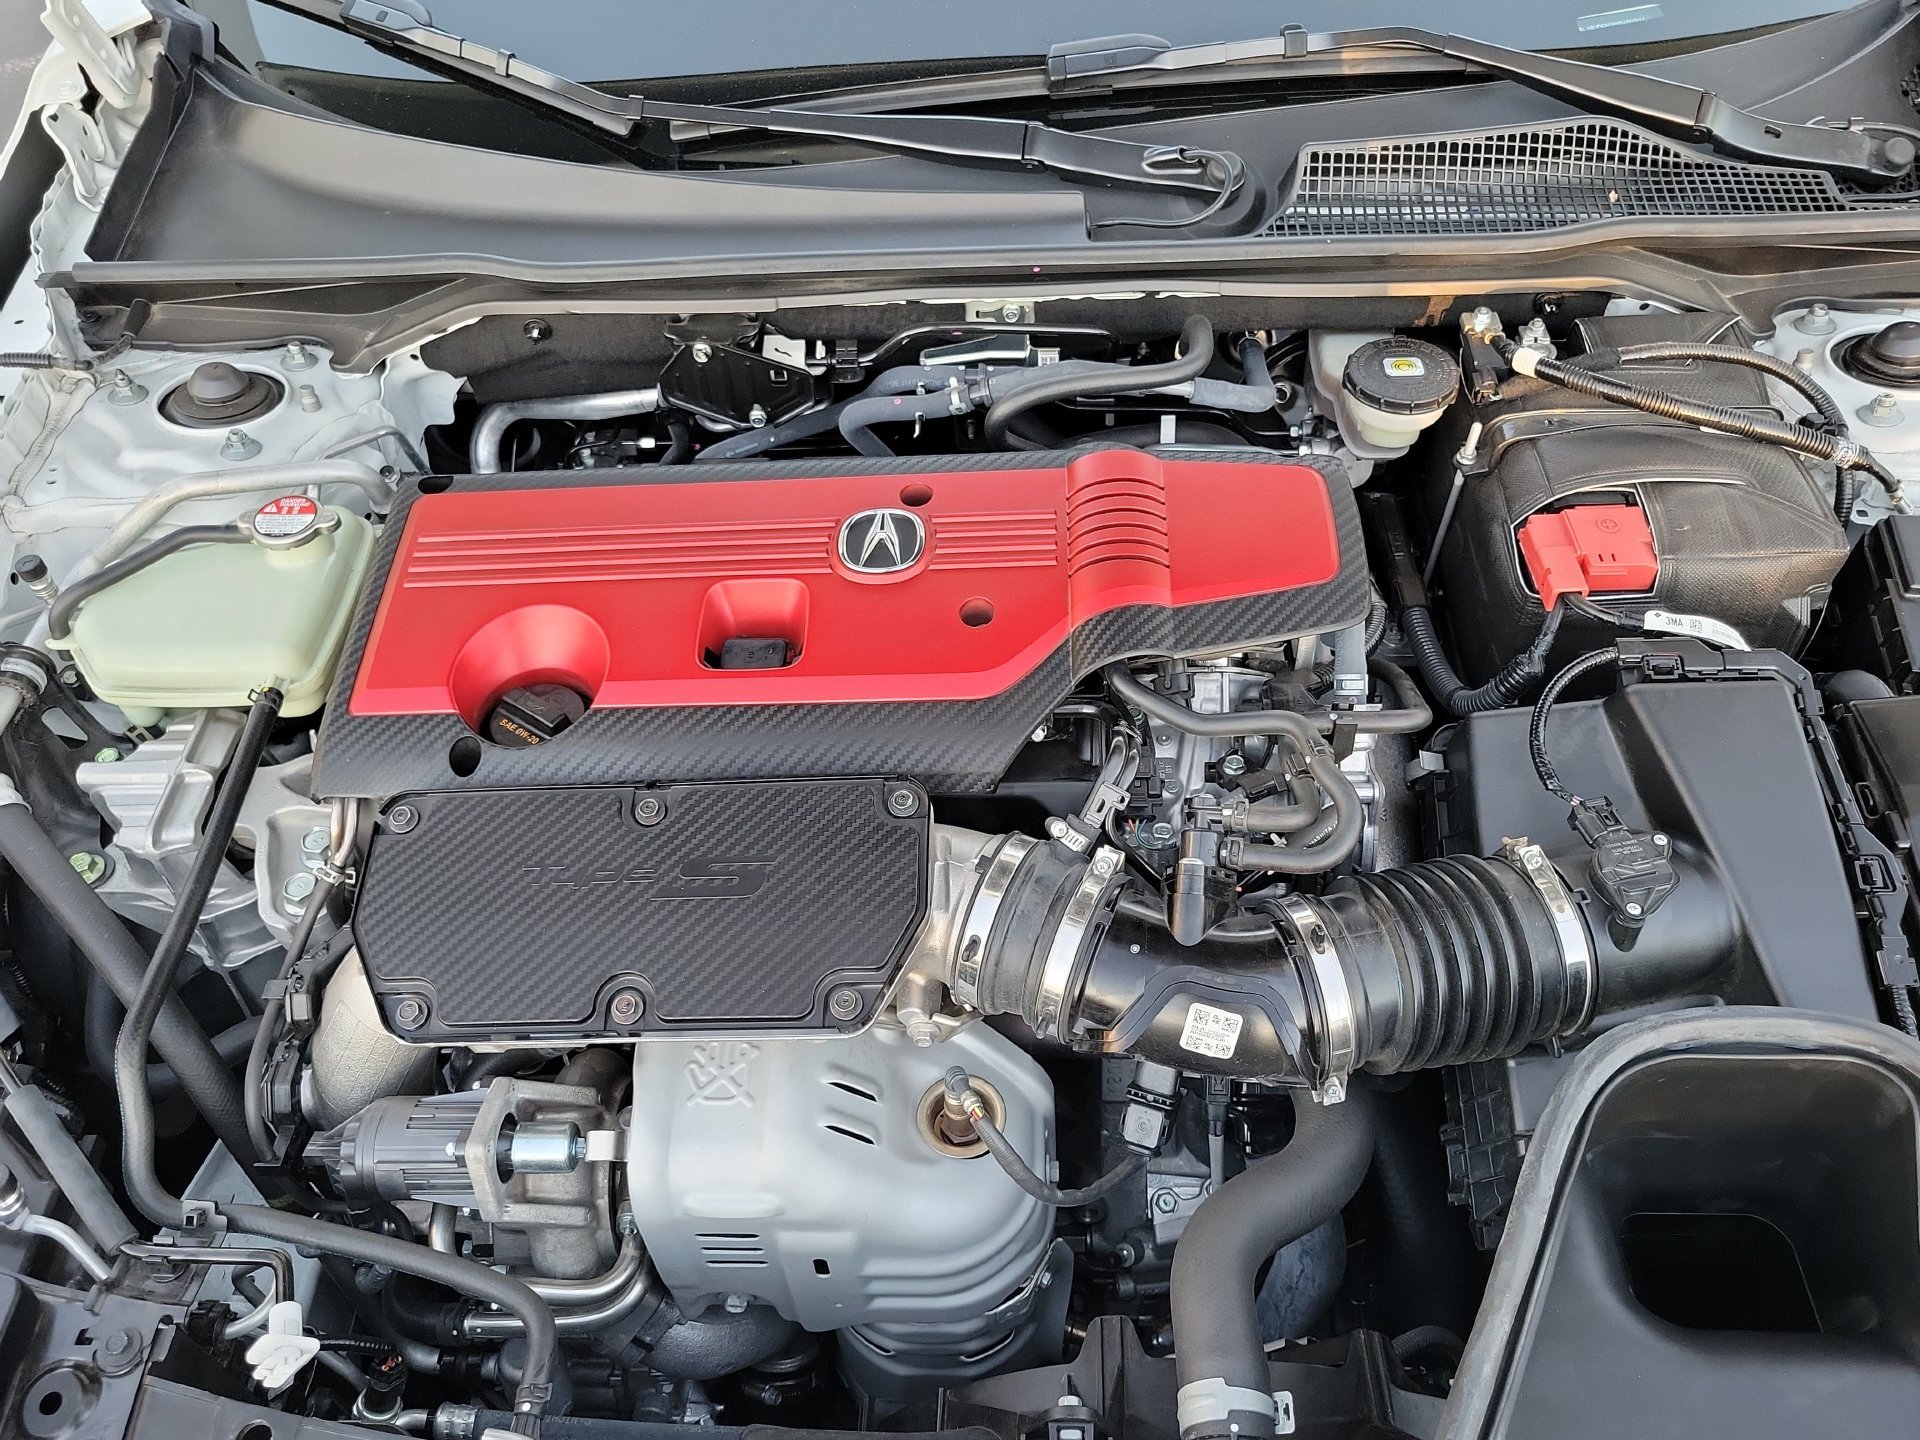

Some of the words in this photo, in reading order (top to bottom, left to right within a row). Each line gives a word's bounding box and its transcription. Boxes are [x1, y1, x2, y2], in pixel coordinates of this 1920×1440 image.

[1665, 617, 1684, 627] 3MA
[500, 719, 517, 732] SAE
[516, 727, 540, 745] 0W-20
[650, 854, 783, 901] S
